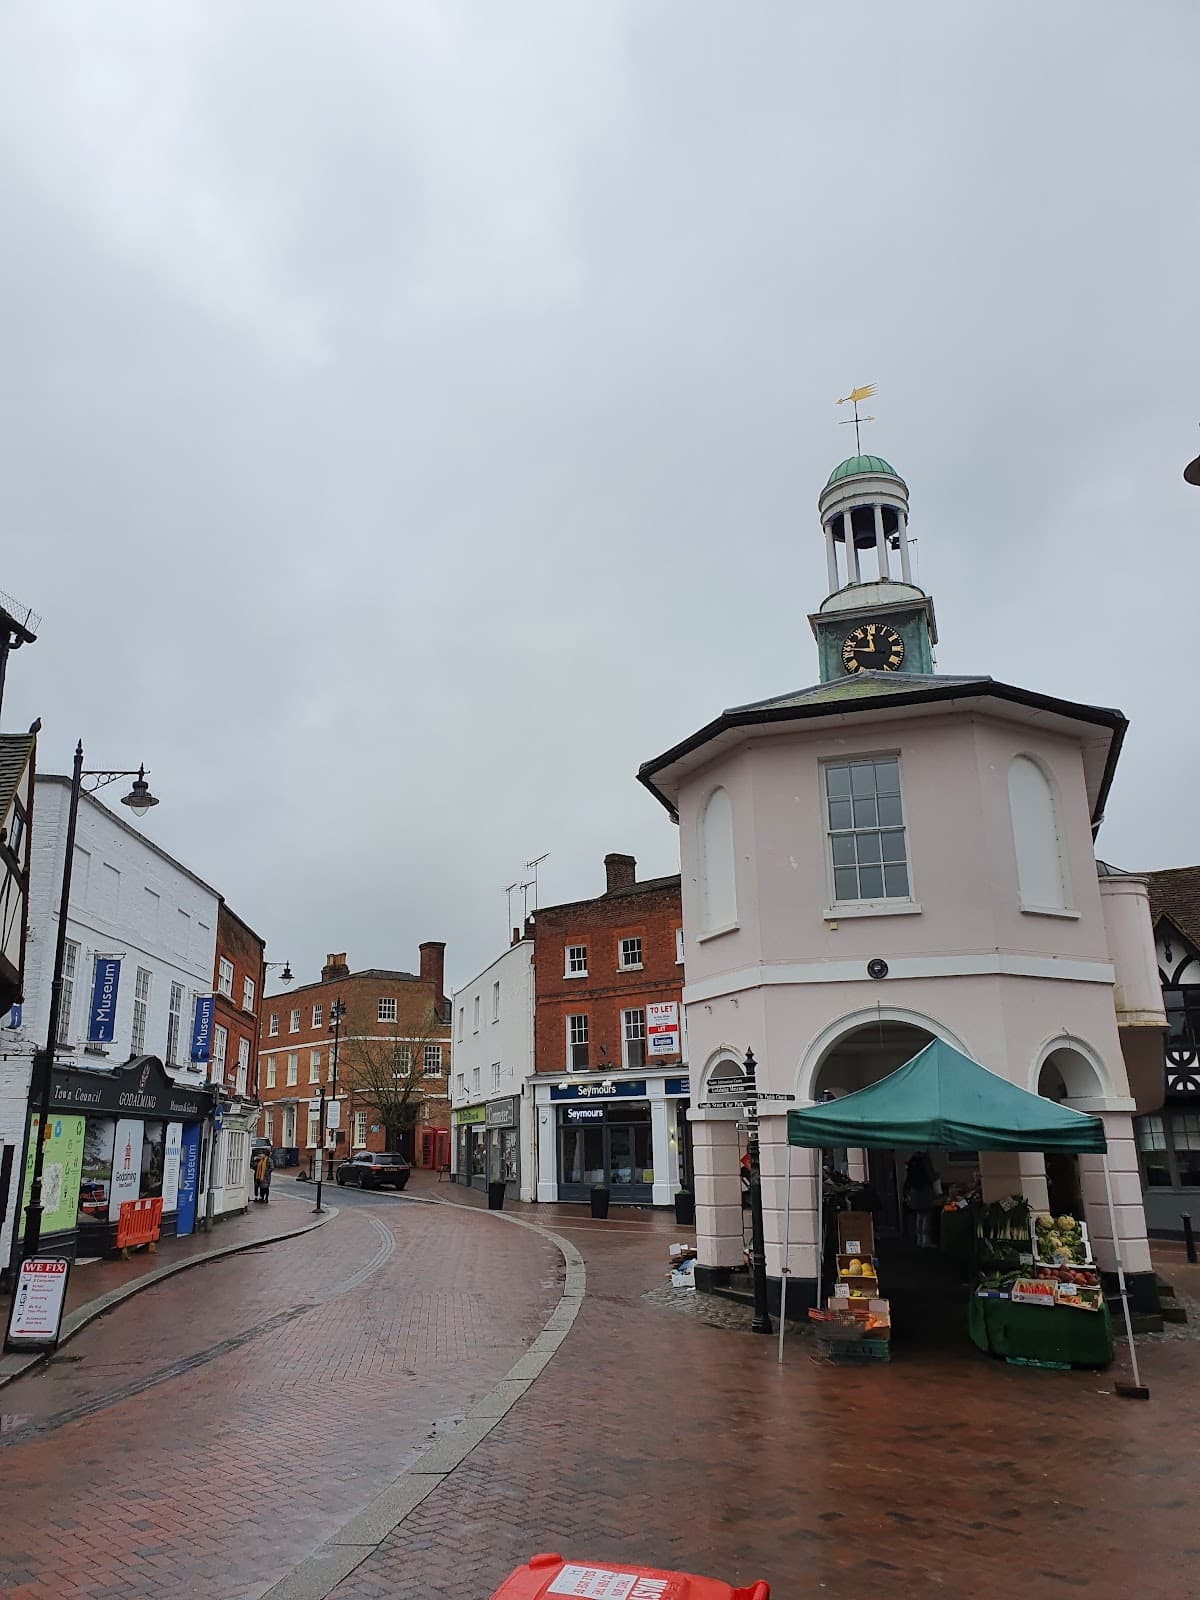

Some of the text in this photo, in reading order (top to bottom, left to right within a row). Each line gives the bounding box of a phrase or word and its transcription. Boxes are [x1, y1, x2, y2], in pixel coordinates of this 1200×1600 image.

[96, 963, 116, 1022] Museum
[650, 1005, 673, 1014] TO LET
[196, 1001, 211, 1046] Museum
[54, 1085, 102, 1103] Town Council
[577, 1085, 617, 1097] Seymours
[119, 1092, 157, 1109] GODALMING
[567, 1108, 604, 1119] Seymours
[183, 1144, 197, 1190] Museum
[25, 1263, 64, 1272] WE FIX
